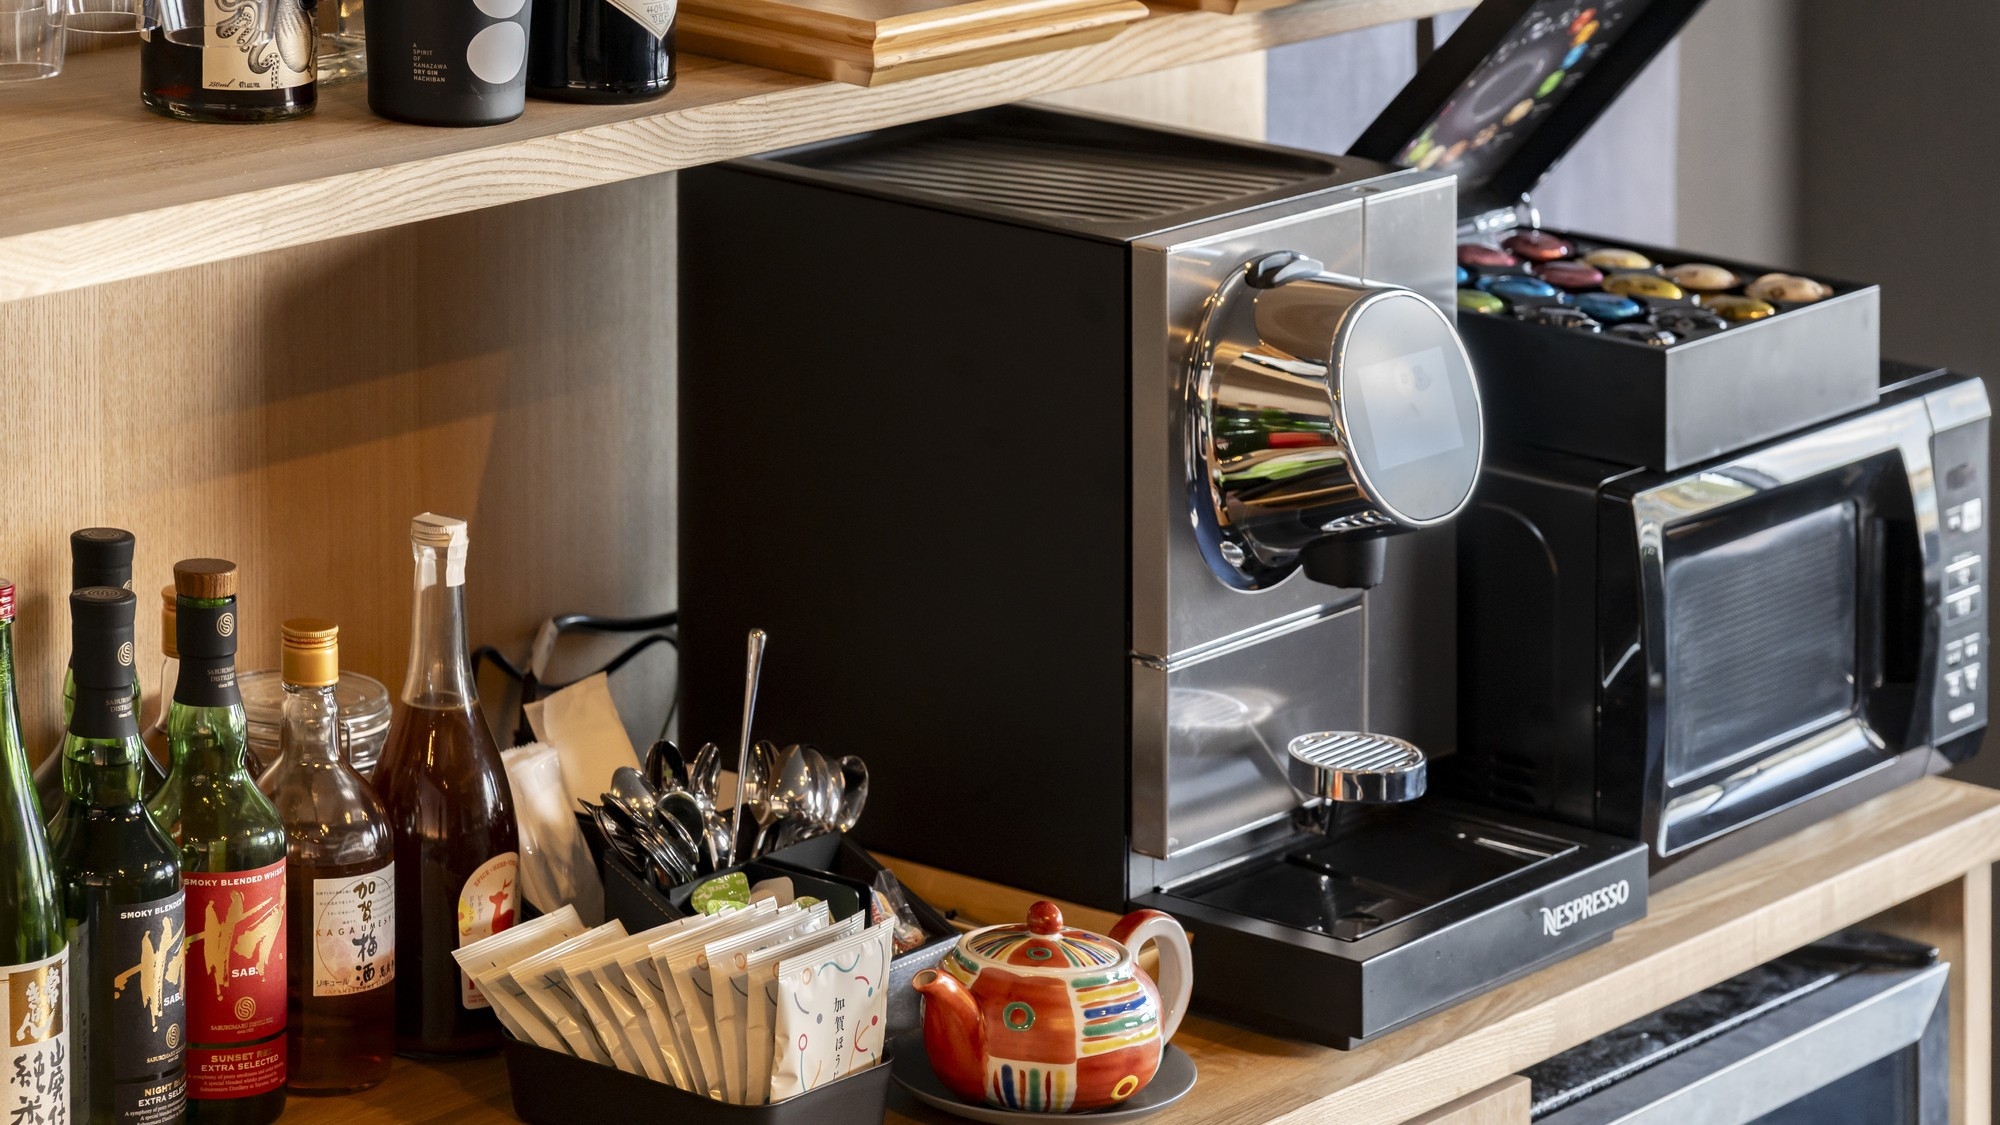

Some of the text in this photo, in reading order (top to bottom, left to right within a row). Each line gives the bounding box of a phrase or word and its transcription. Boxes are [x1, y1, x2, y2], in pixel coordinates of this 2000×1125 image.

[413, 75, 446, 83] HACHIBAN
[220, 875, 263, 887] BLENDED
[120, 898, 182, 919] SMOKY BLENDED
[1539, 879, 1629, 936] NESPRESSO
[316, 978, 350, 988] リキュール
[201, 1064, 235, 1072] EXTRA
[237, 1054, 279, 1071] SELECTED
[211, 1052, 254, 1063] SUNSET
[144, 1082, 173, 1097] NIGHT
[138, 1095, 167, 1107] EXTRA
